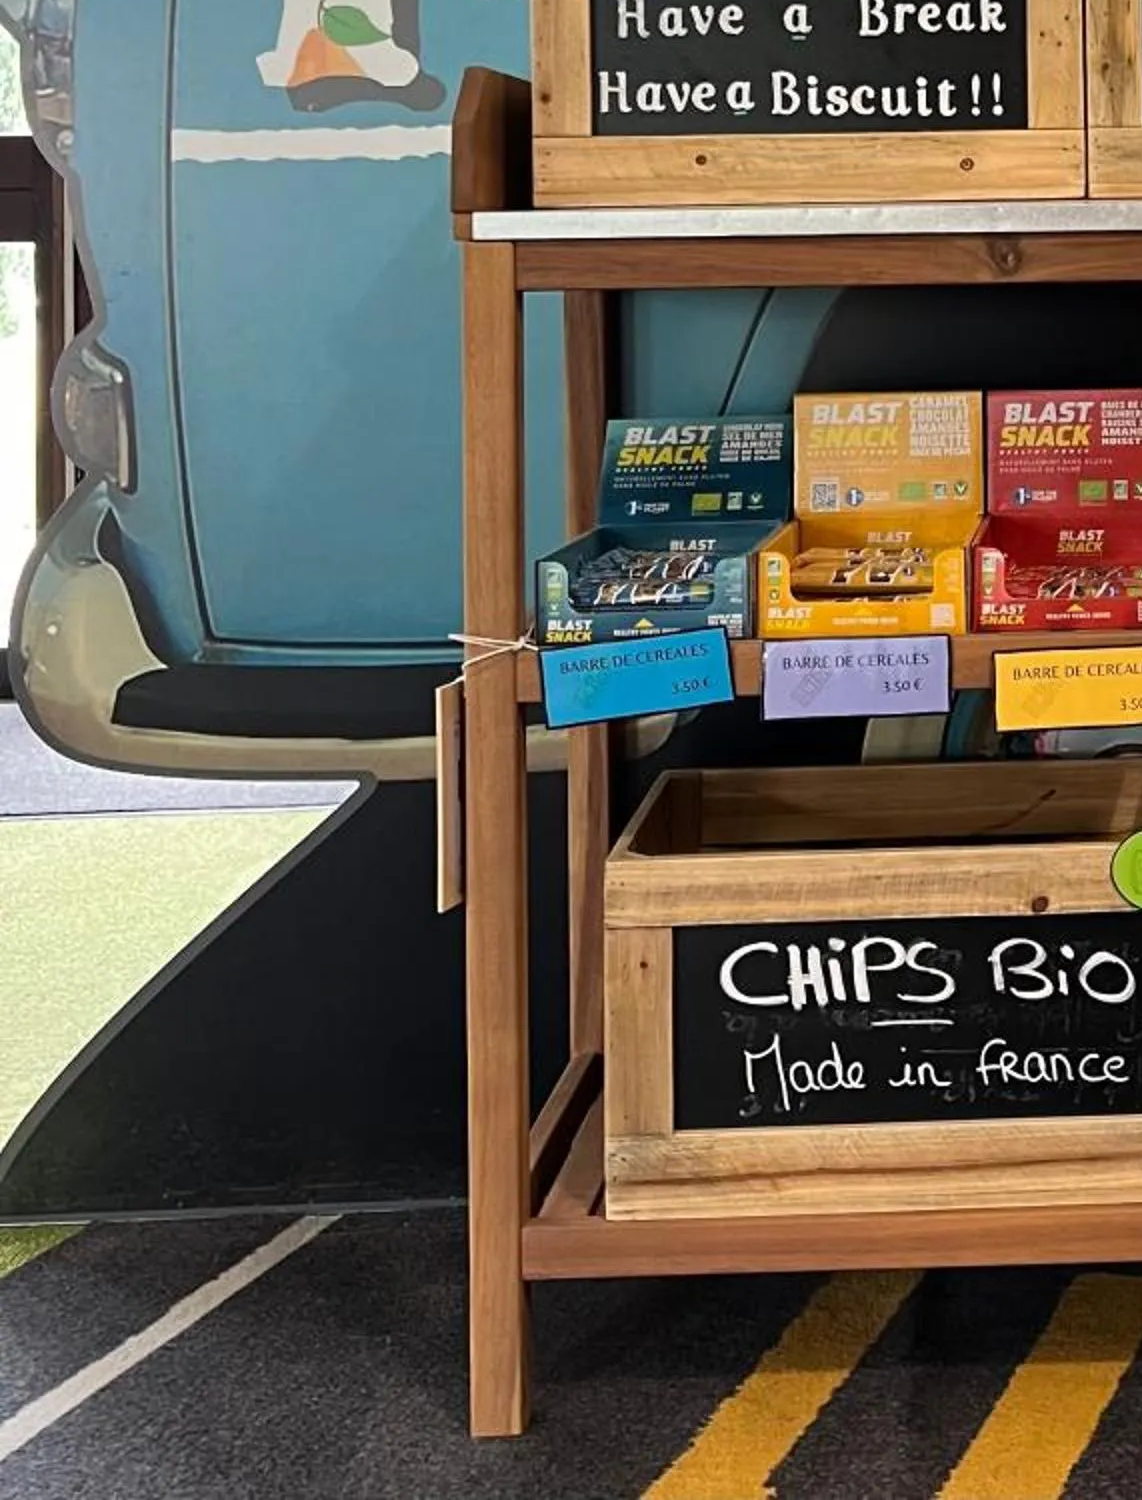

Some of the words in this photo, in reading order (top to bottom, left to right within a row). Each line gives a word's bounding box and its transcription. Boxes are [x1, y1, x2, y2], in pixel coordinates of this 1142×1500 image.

[782, 2, 813, 41] a
[598, 71, 719, 114] Have
[725, 80, 756, 116] a
[812, 403, 902, 424] BLAST
[1004, 401, 1094, 424] BLAST
[623, 425, 716, 446] BLAST
[807, 425, 899, 448] SNACK
[999, 424, 1092, 448] SNACK
[617, 444, 711, 467] SNACK
[669, 539, 717, 551] BLAST
[867, 531, 913, 543] BLAST
[1059, 529, 1104, 541] BLAST
[1056, 541, 1104, 553] SNACK
[767, 607, 812, 619] BLAST
[980, 603, 1026, 615] BLAST
[547, 619, 593, 631] BLAST
[979, 614, 1025, 625] SNACK
[545, 631, 593, 643] SNACK
[559, 657, 609, 675] BARRE
[612, 655, 632, 668] DE
[635, 643, 709, 666] CEREALES
[782, 654, 831, 670] BARRE
[835, 653, 855, 668] DE
[856, 650, 930, 668] CEREALES
[1012, 665, 1060, 681] BARRE
[1063, 664, 1083, 679] DE
[719, 935, 956, 1010] CHiPS
[743, 1033, 866, 1111] Made
[888, 1046, 952, 1089] in
